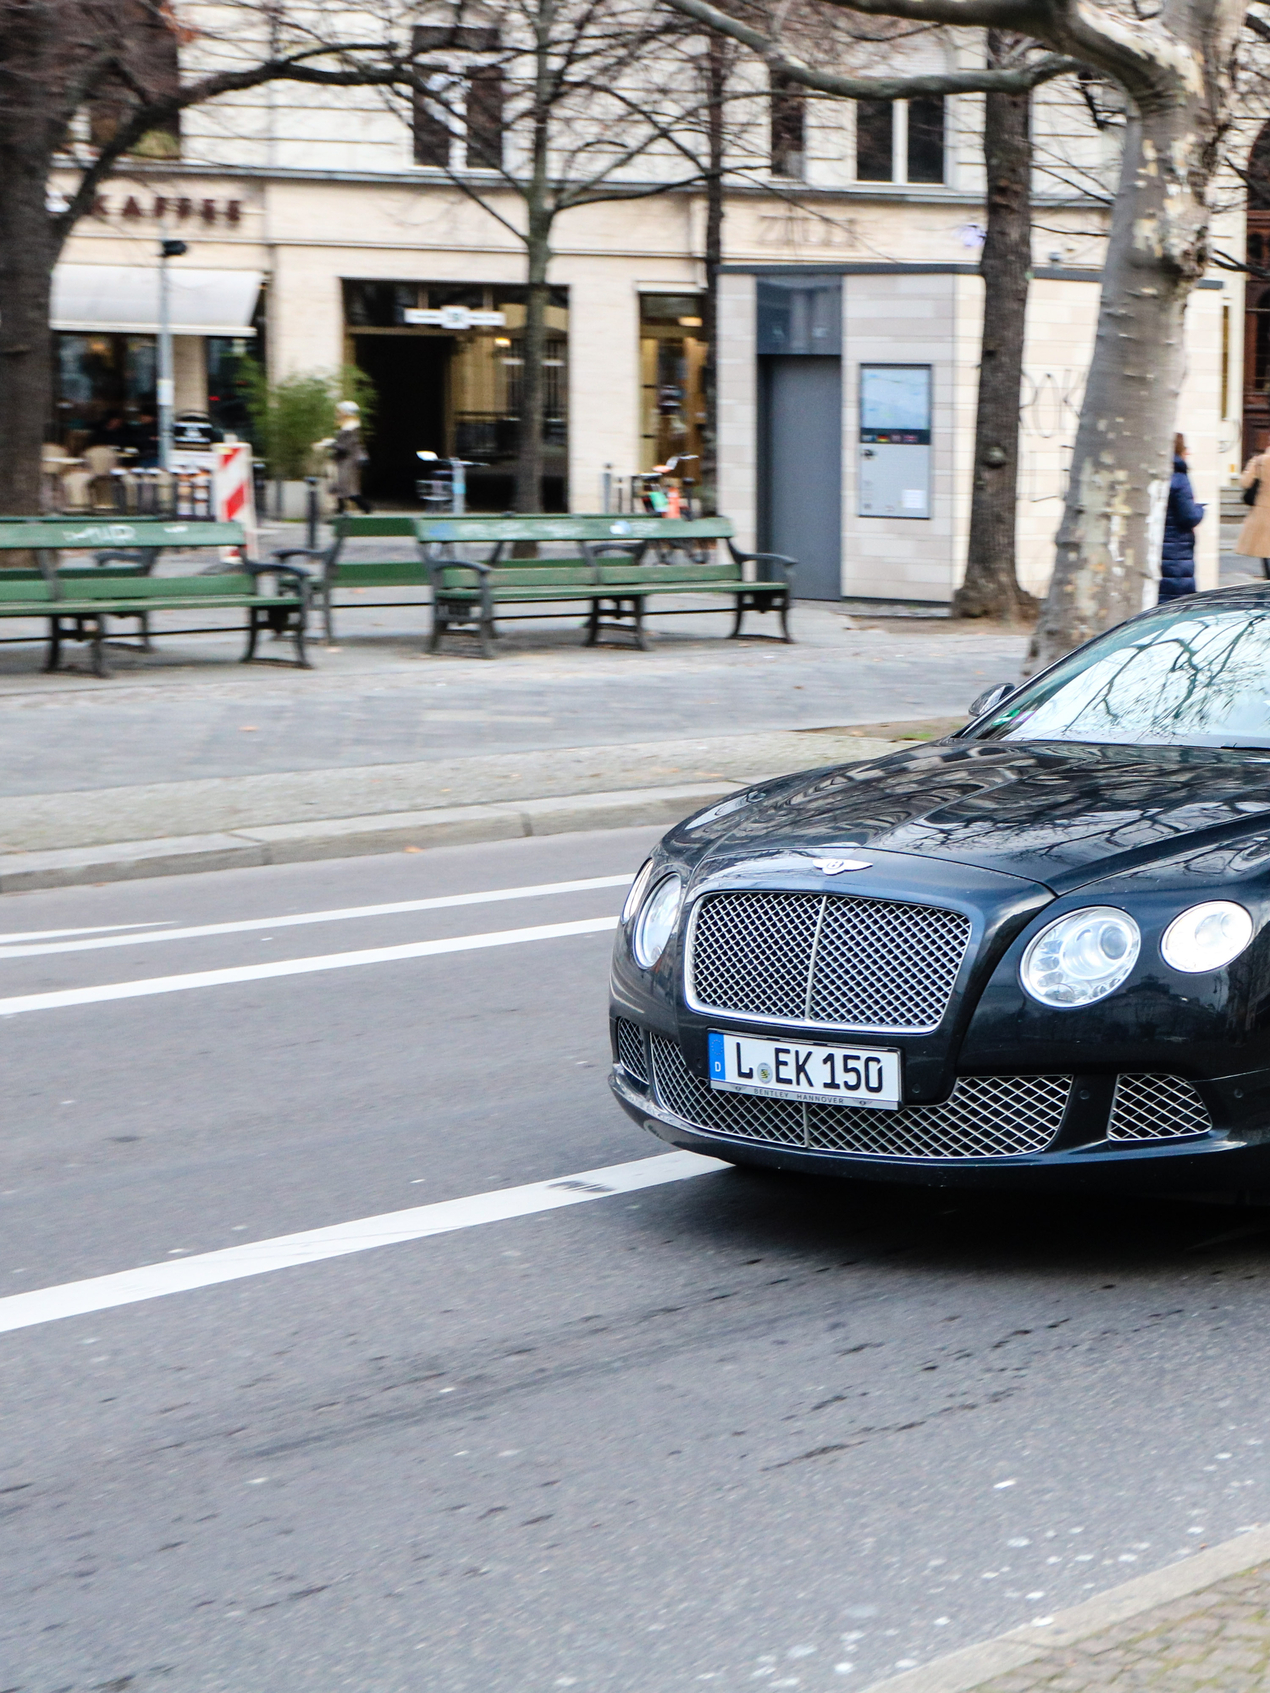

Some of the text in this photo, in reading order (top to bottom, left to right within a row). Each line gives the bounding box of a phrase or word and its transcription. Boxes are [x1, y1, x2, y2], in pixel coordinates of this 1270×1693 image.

[91, 195, 242, 221] KAFFEE
[714, 1061, 722, 1073] D
[736, 1042, 884, 1094] L EK 150
[753, 1088, 844, 1104] BENTLEY HANNOVER
